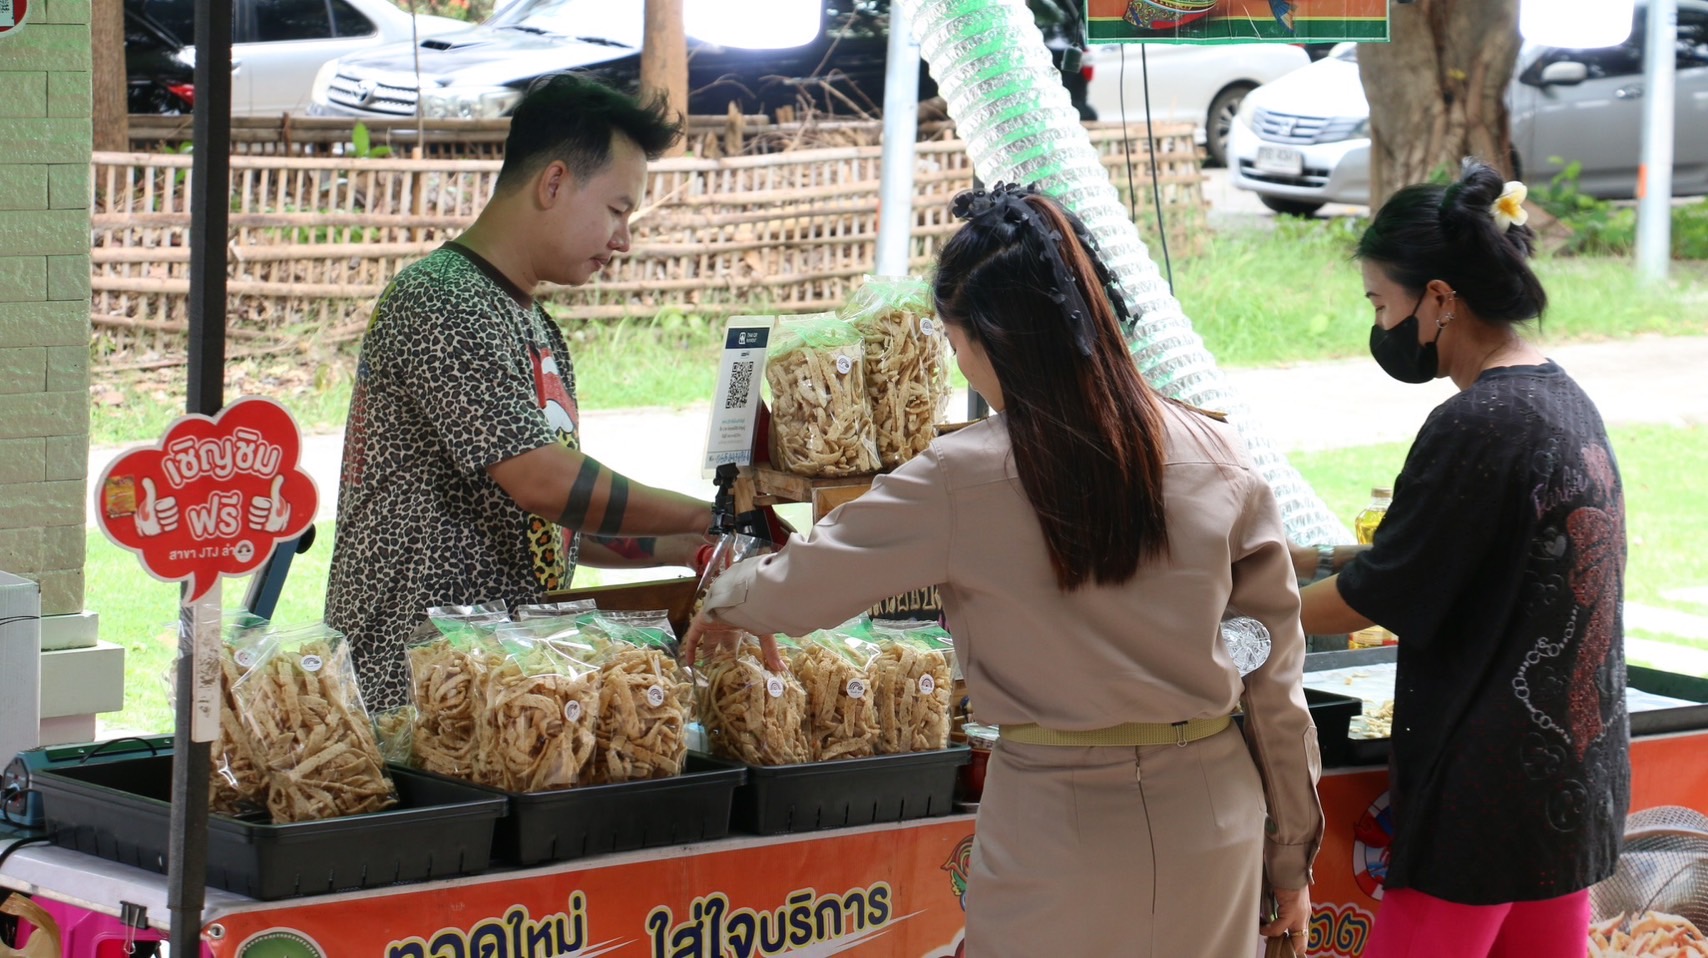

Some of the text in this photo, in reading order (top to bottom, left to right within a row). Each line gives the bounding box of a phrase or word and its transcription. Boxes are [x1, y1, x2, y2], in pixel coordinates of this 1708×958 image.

[163, 427, 281, 487] เชิญชิม
[187, 491, 241, 539] ฟรี
[169, 549, 196, 560] สาขา
[199, 547, 219, 558] JTJ
[647, 884, 890, 958] ใส่ใจบริการ
